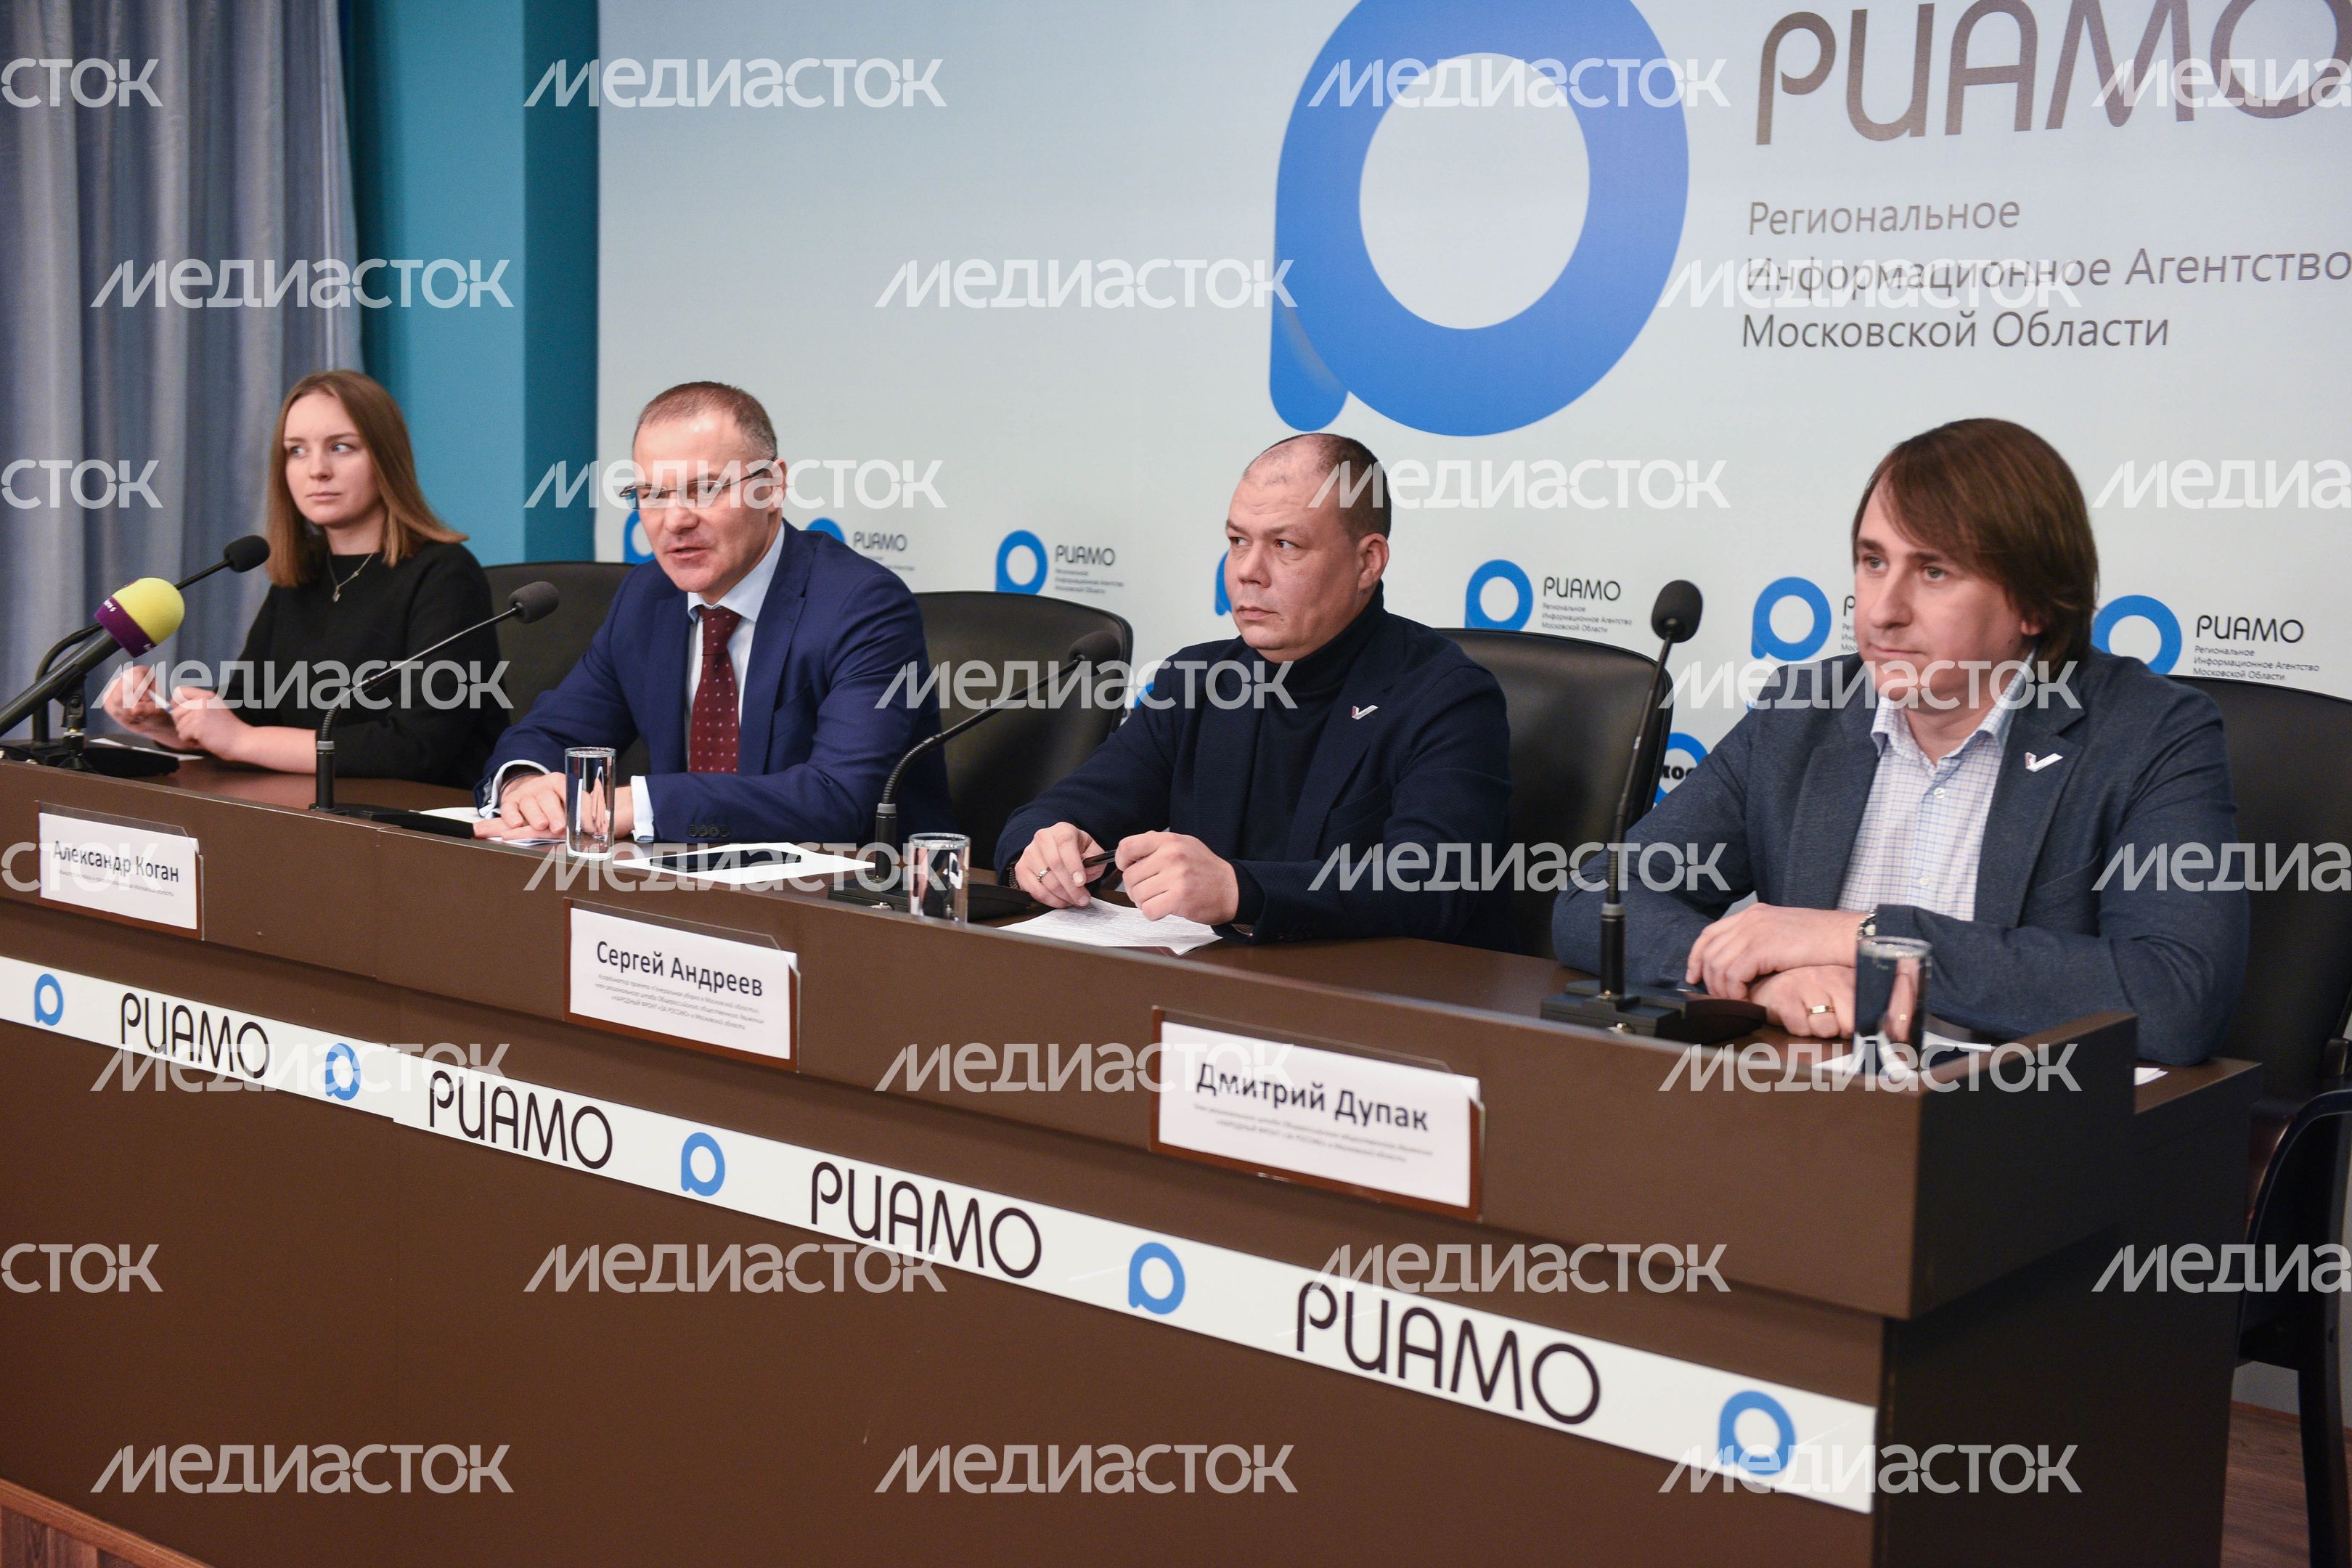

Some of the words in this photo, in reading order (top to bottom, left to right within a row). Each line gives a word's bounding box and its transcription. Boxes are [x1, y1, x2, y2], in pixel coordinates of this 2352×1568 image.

[1756, 0, 2352, 145] РИАМО
[1748, 198, 2020, 236] Региональное
[1747, 252, 2110, 301] Информационное
[2126, 248, 2352, 285] Агентство
[1742, 309, 1977, 349] Московской
[1993, 311, 2169, 348] Области
[1055, 544, 1116, 566] РИАМО
[1544, 576, 1621, 601] РИАМО
[2196, 615, 2304, 644] РИАМО
[2194, 645, 2255, 657] Региональное
[2194, 656, 2274, 670] Информационное
[2276, 660, 2320, 672] Агентство
[2193, 666, 2246, 679] Московской
[2248, 669, 2286, 681] Области
[54, 841, 131, 878] Александр
[136, 855, 179, 883] Коган
[597, 940, 664, 976] Сергей
[670, 957, 763, 997] Андреев
[121, 992, 270, 1079] РИАМО
[1196, 1063, 1326, 1112] Дмитрий
[1334, 1090, 1429, 1132] Дупак
[429, 1069, 613, 1170] РИАМО
[811, 1161, 1042, 1278] РИАМО
[1296, 1281, 1601, 1425] РИАМО
